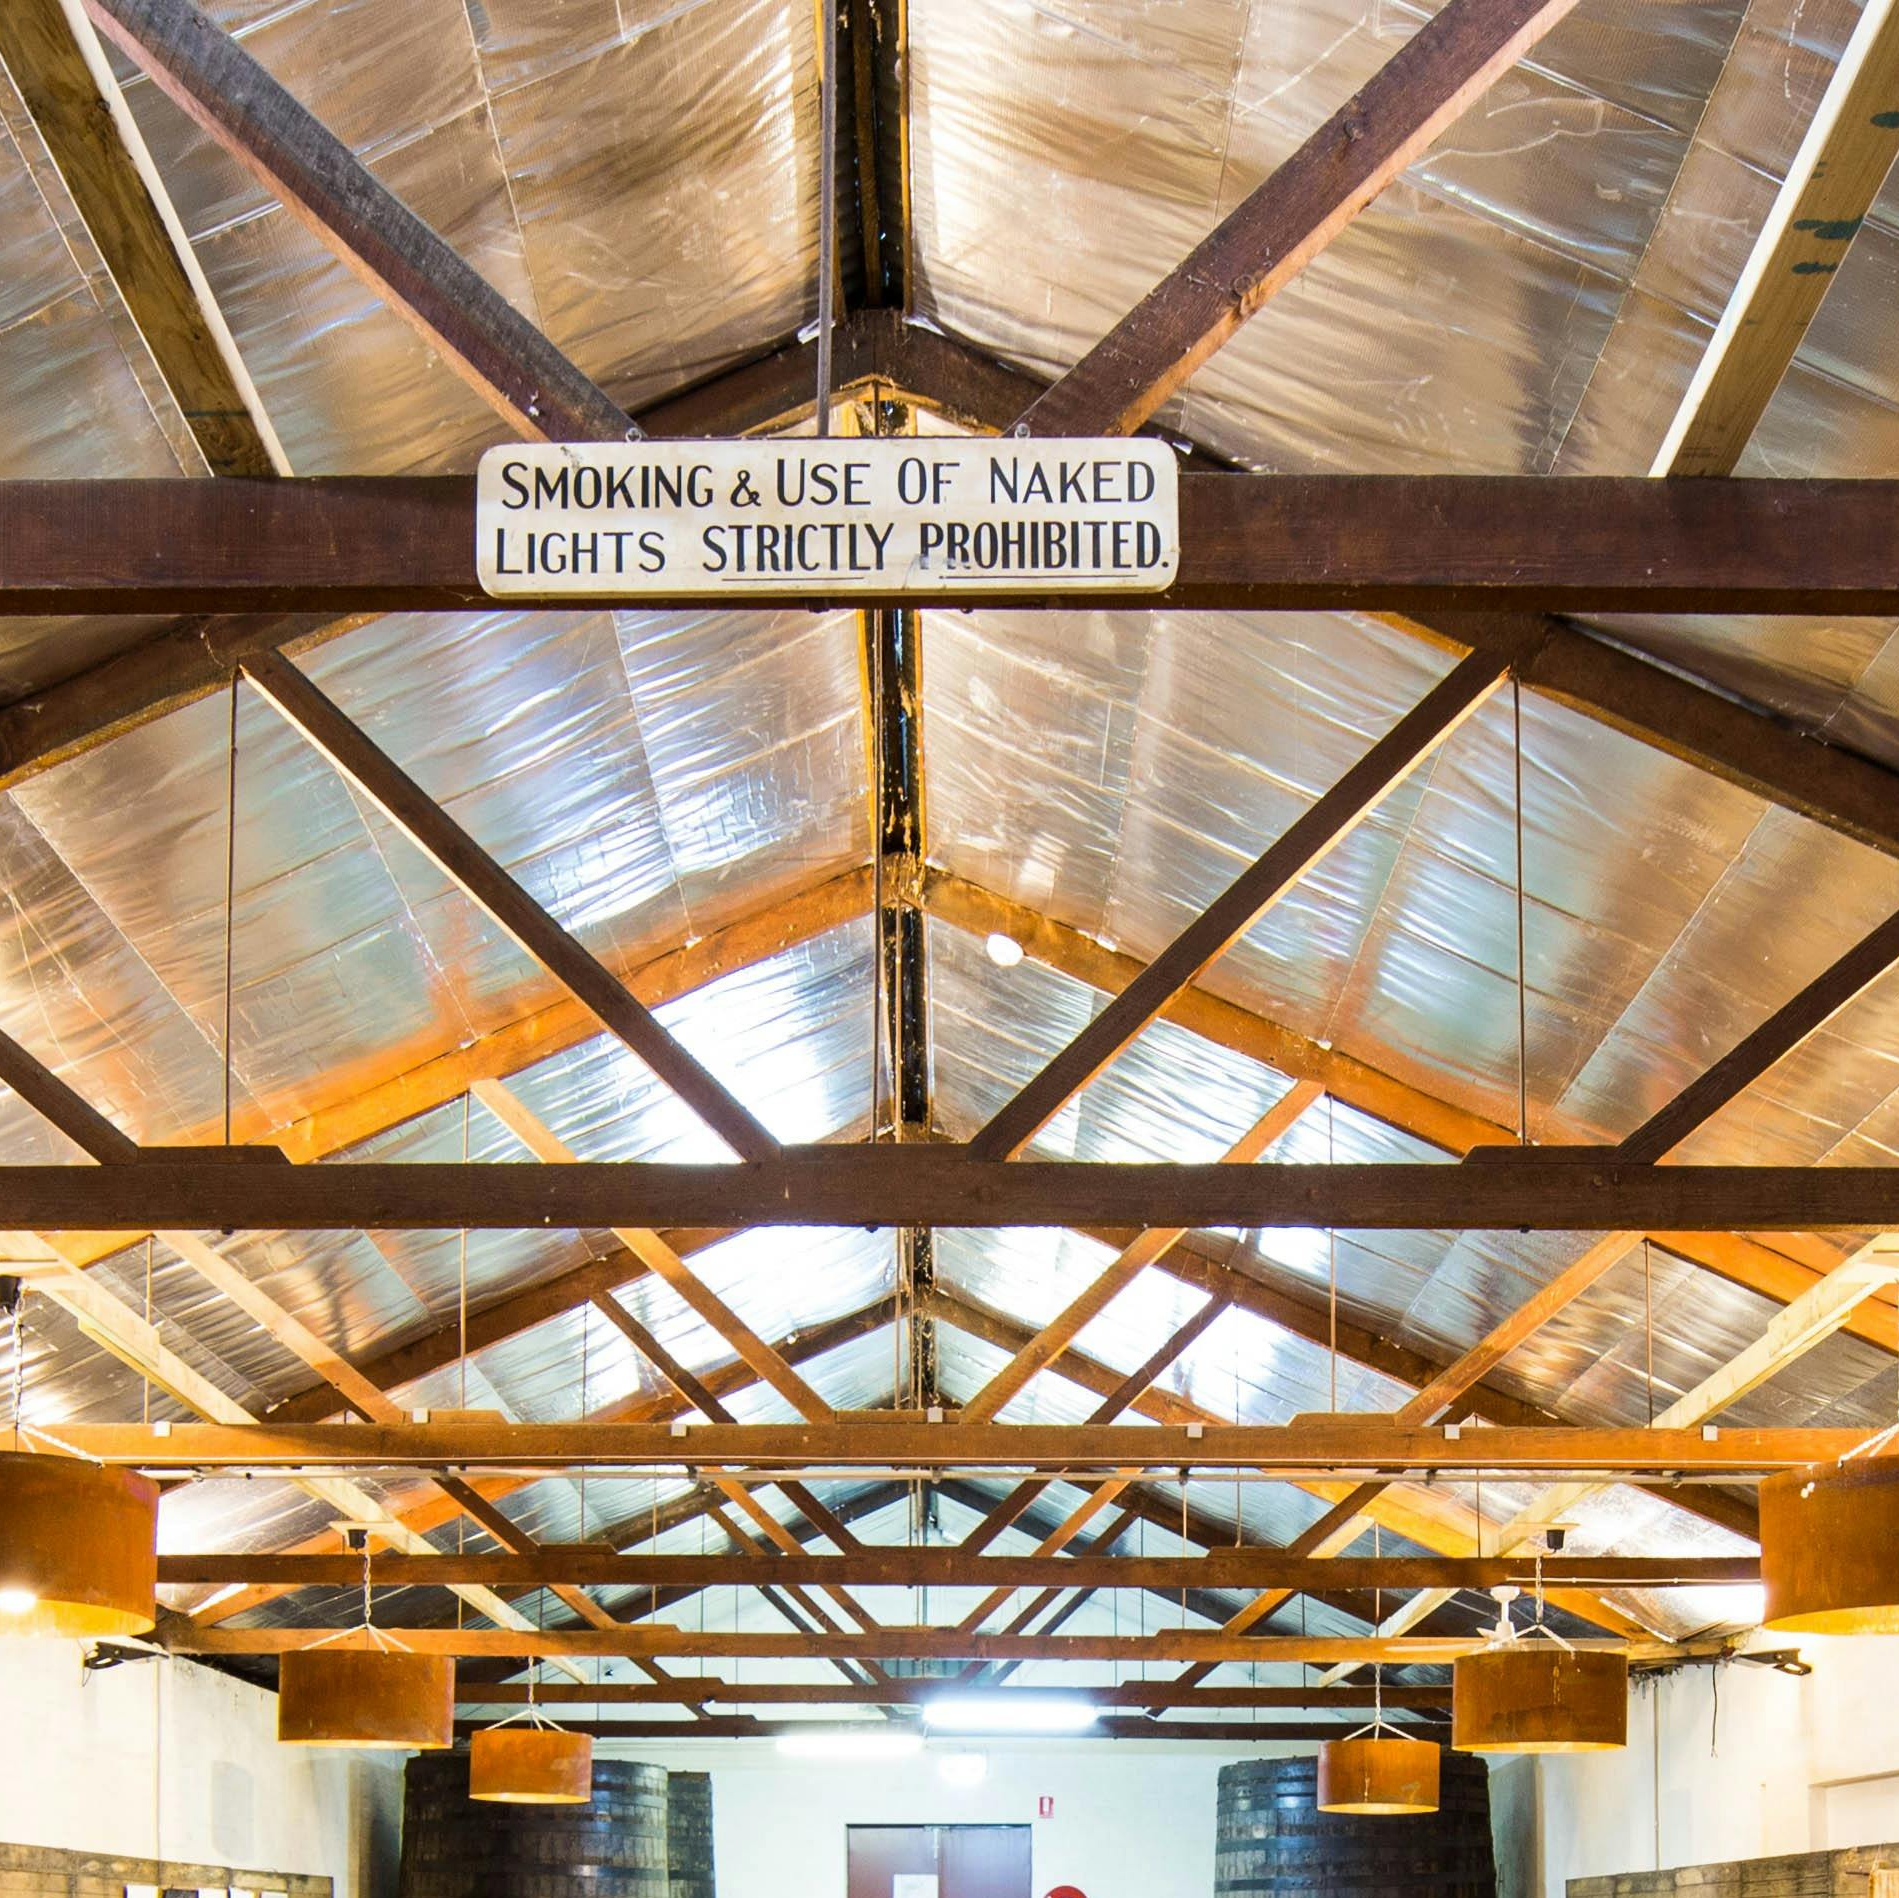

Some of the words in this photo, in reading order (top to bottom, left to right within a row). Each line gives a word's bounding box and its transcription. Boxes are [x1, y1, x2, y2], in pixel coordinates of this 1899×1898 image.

[503, 463, 712, 509] SMOKING
[731, 471, 761, 507] &
[778, 459, 870, 506] USE
[898, 458, 959, 504] OF
[991, 458, 1154, 503] NAKED
[497, 529, 664, 573] LIGHTS
[703, 523, 894, 571] STRICTLY
[921, 522, 1169, 568] PROHIBITED.
